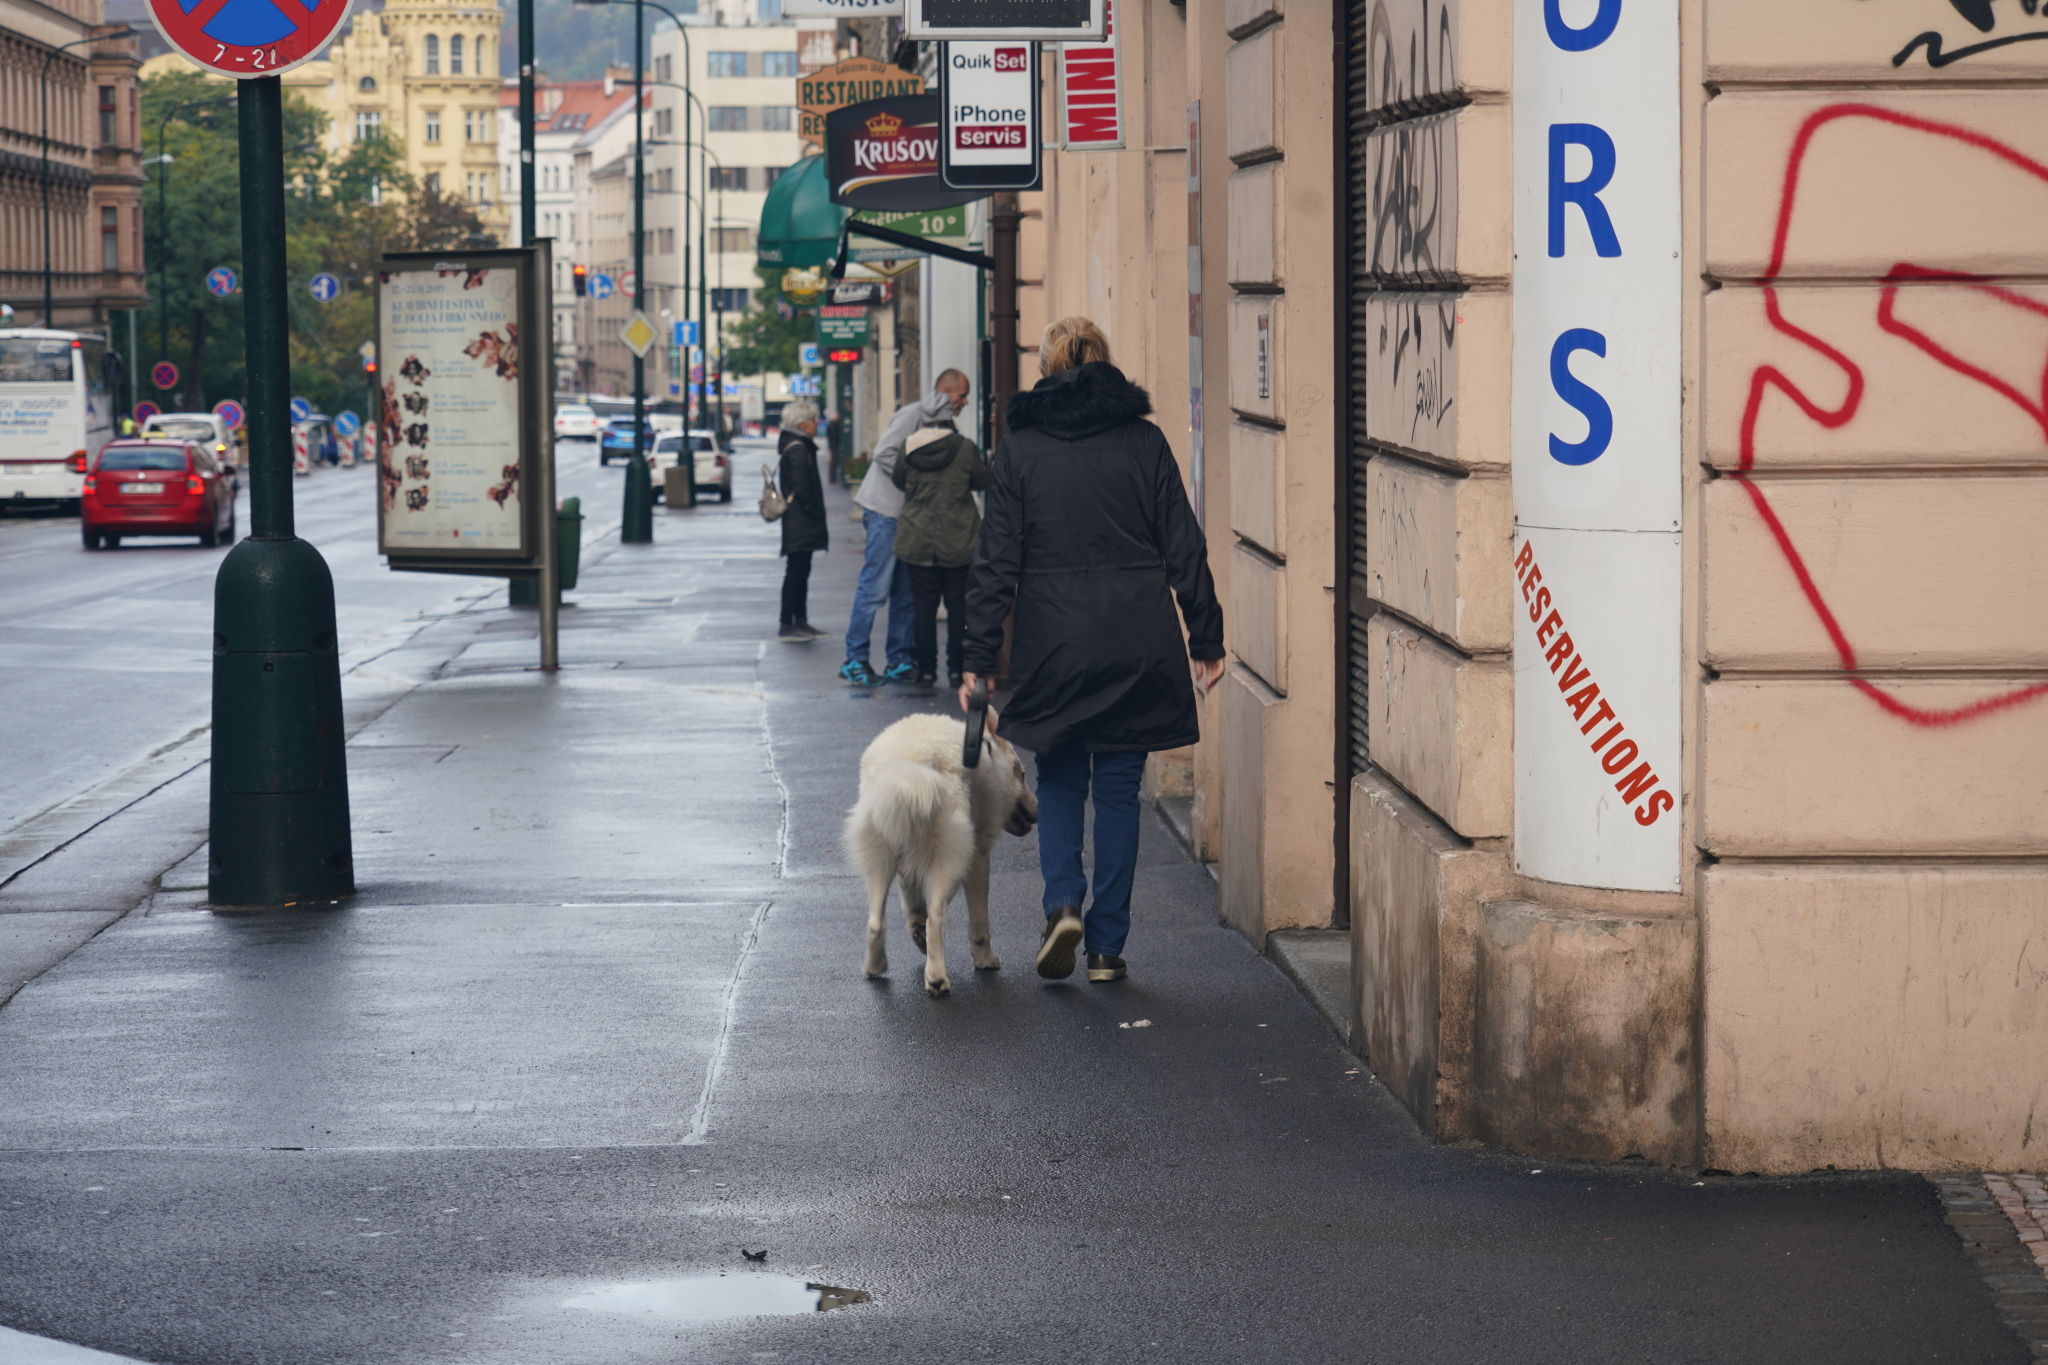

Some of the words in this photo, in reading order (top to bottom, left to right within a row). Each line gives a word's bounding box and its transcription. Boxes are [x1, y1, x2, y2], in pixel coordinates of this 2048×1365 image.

[953, 54, 992, 69] Quik
[996, 53, 1026, 69] Set
[802, 79, 919, 105] RESTAURANT
[1064, 48, 1118, 142] MINI
[954, 105, 1026, 122] iPhone
[960, 127, 1022, 145] servis
[919, 216, 957, 234] 10°
[1514, 539, 1674, 826] RESERVATIONS
